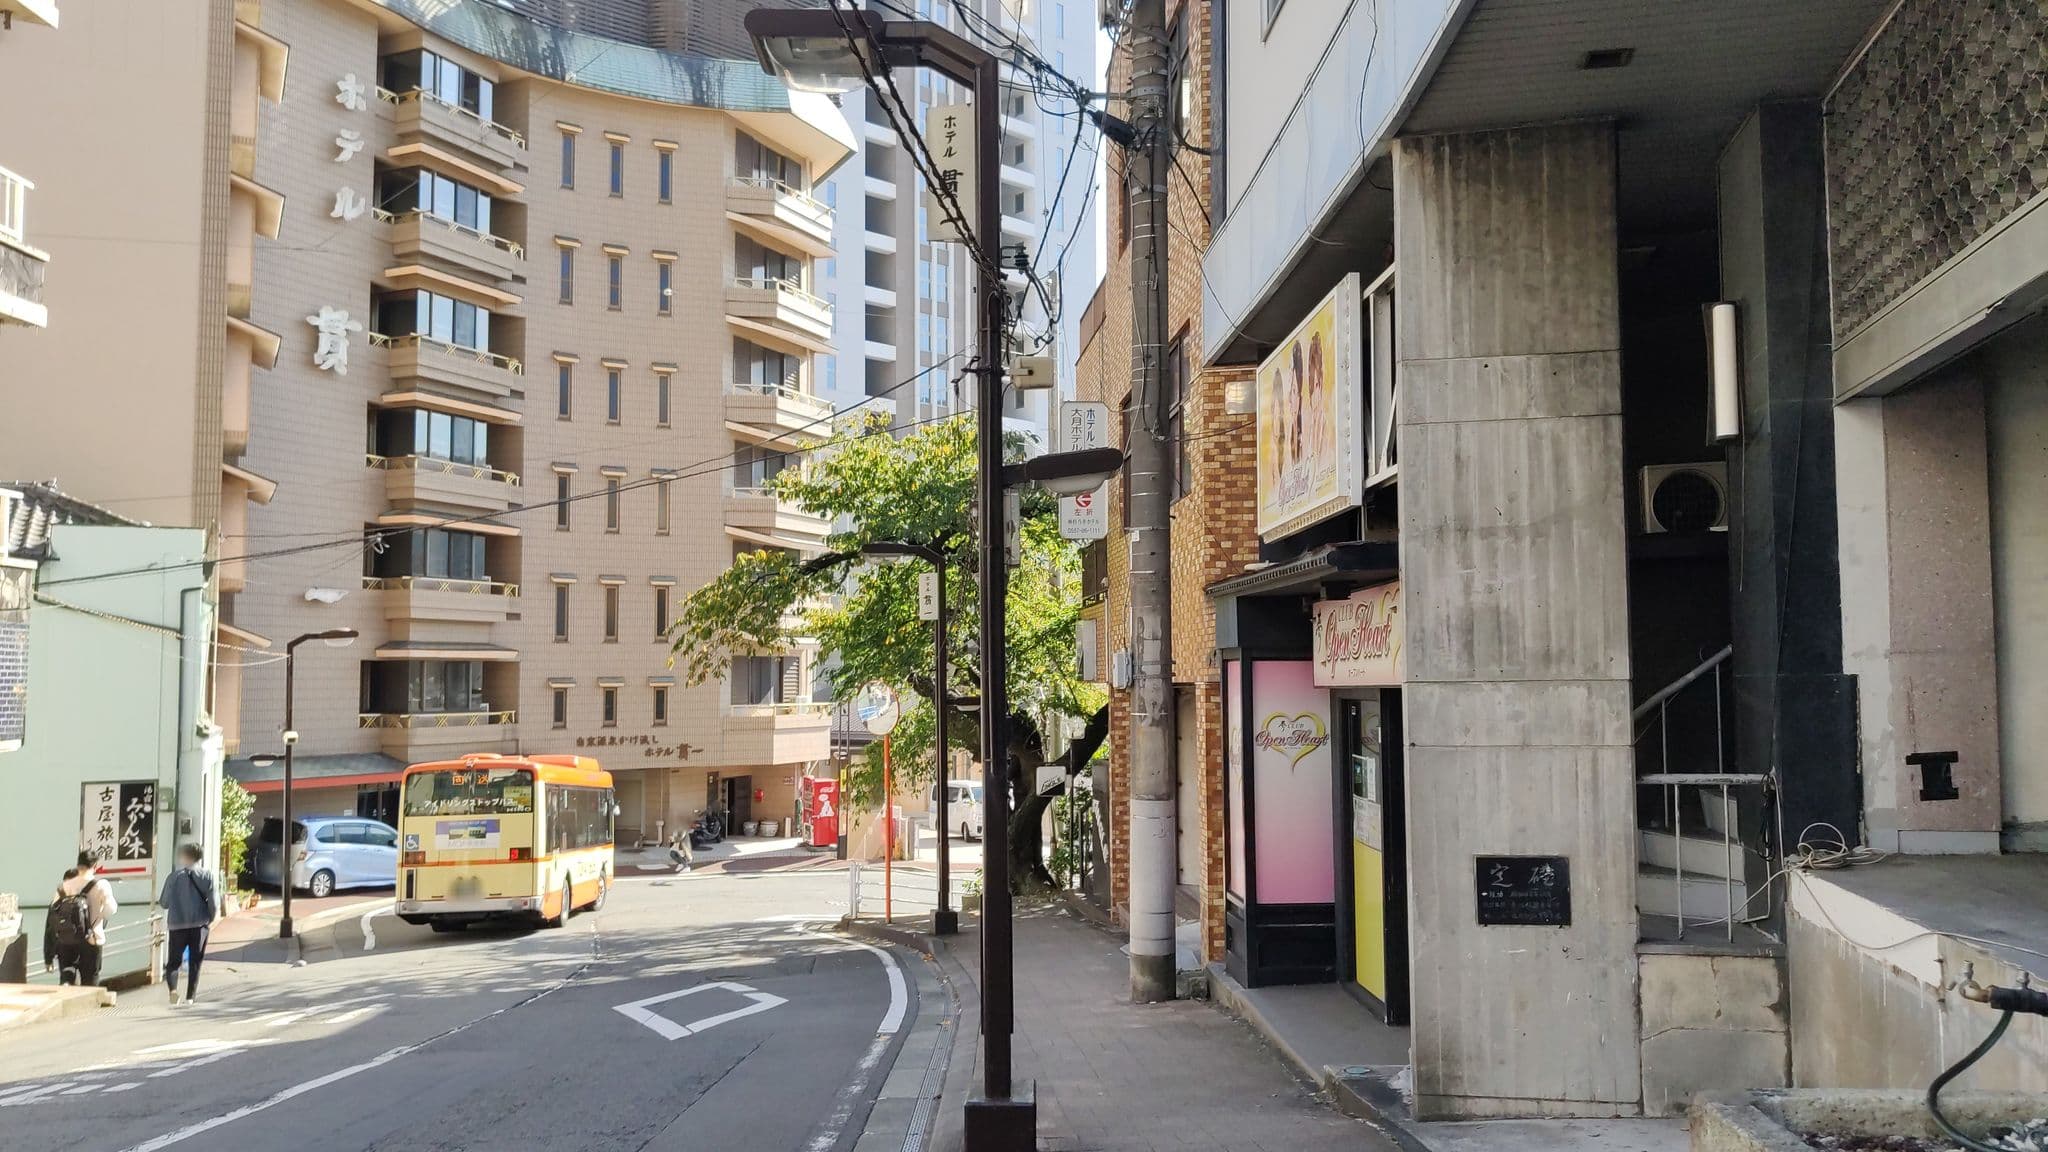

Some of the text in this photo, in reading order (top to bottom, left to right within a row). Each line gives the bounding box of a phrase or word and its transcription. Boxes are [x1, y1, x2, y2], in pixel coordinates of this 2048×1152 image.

[1325, 600, 1392, 679] Open Heart
[1256, 729, 1330, 751] Open Heart
[96, 786, 115, 861] 古屋旅館
